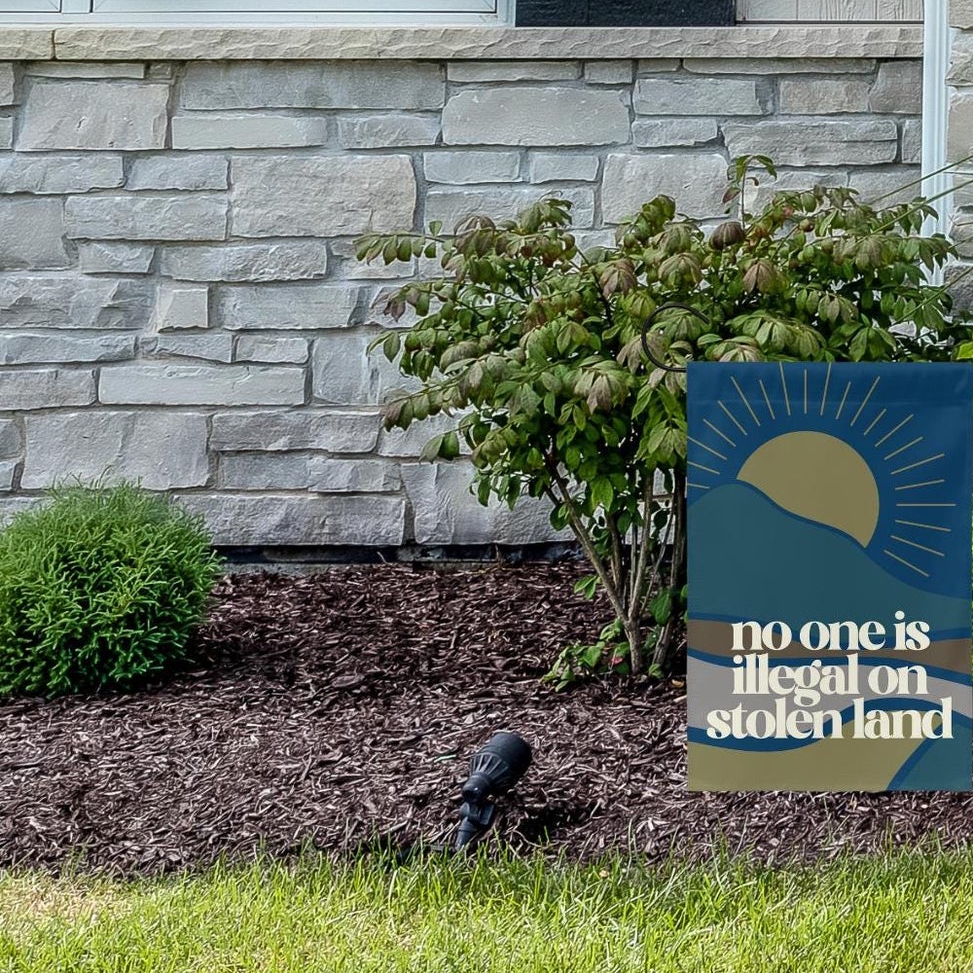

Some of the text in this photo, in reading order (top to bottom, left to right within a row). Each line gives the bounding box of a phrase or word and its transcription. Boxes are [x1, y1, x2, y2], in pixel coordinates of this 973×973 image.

[731, 610, 930, 651] no one is
[732, 652, 929, 708] illegal on
[706, 697, 954, 739] stolen land
